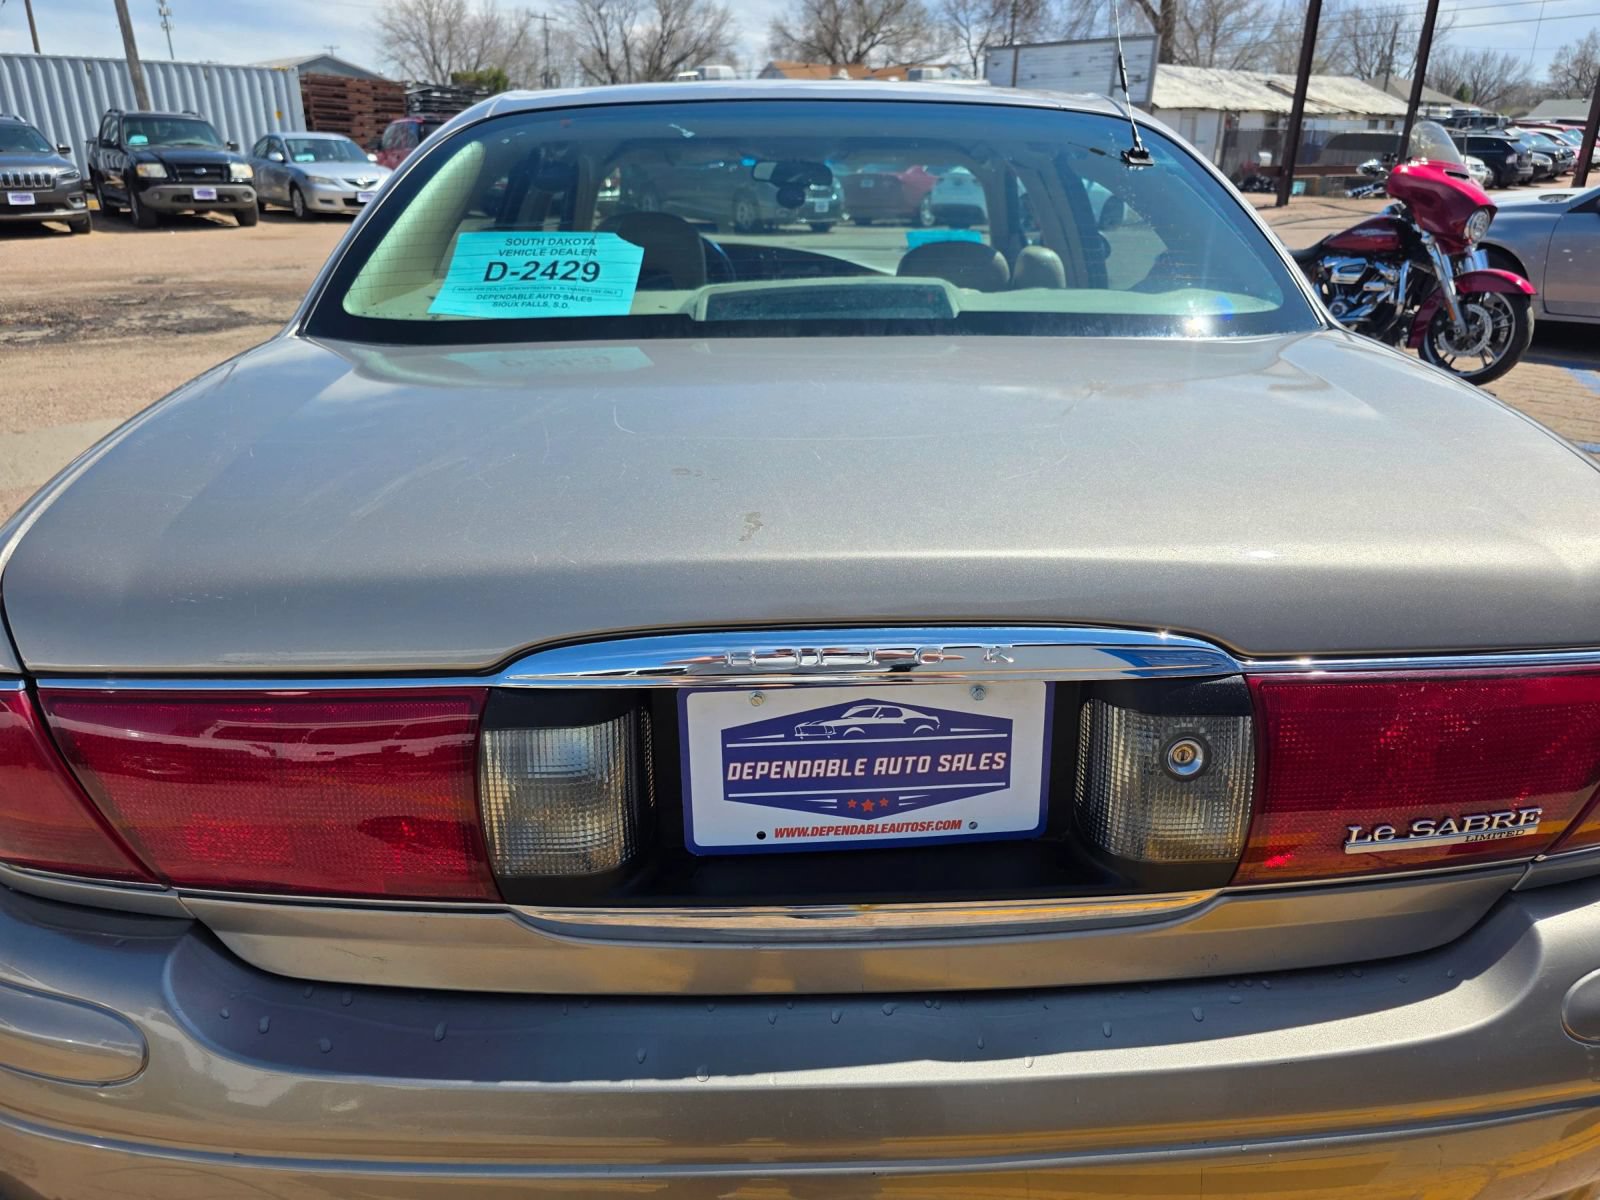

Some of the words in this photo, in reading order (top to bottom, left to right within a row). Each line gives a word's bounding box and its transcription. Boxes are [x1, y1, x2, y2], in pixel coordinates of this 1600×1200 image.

[505, 238, 546, 247] SOUTH
[547, 237, 597, 246] DAKOTA
[498, 248, 545, 257] VEHICLE
[549, 247, 598, 257] DEALER
[483, 259, 601, 283] D-2429
[476, 293, 535, 301] DEPENDABLE
[536, 293, 561, 301] AUTO
[562, 294, 593, 303] SALES
[727, 757, 867, 782] DEPENDABLE
[873, 755, 932, 776] AUTO
[937, 752, 1008, 774] SALES
[774, 819, 962, 840] WWW.DEPENDABLEAUTOSF.COM
[1409, 806, 1543, 839] SABRE
[1464, 829, 1526, 843] LIMITED
